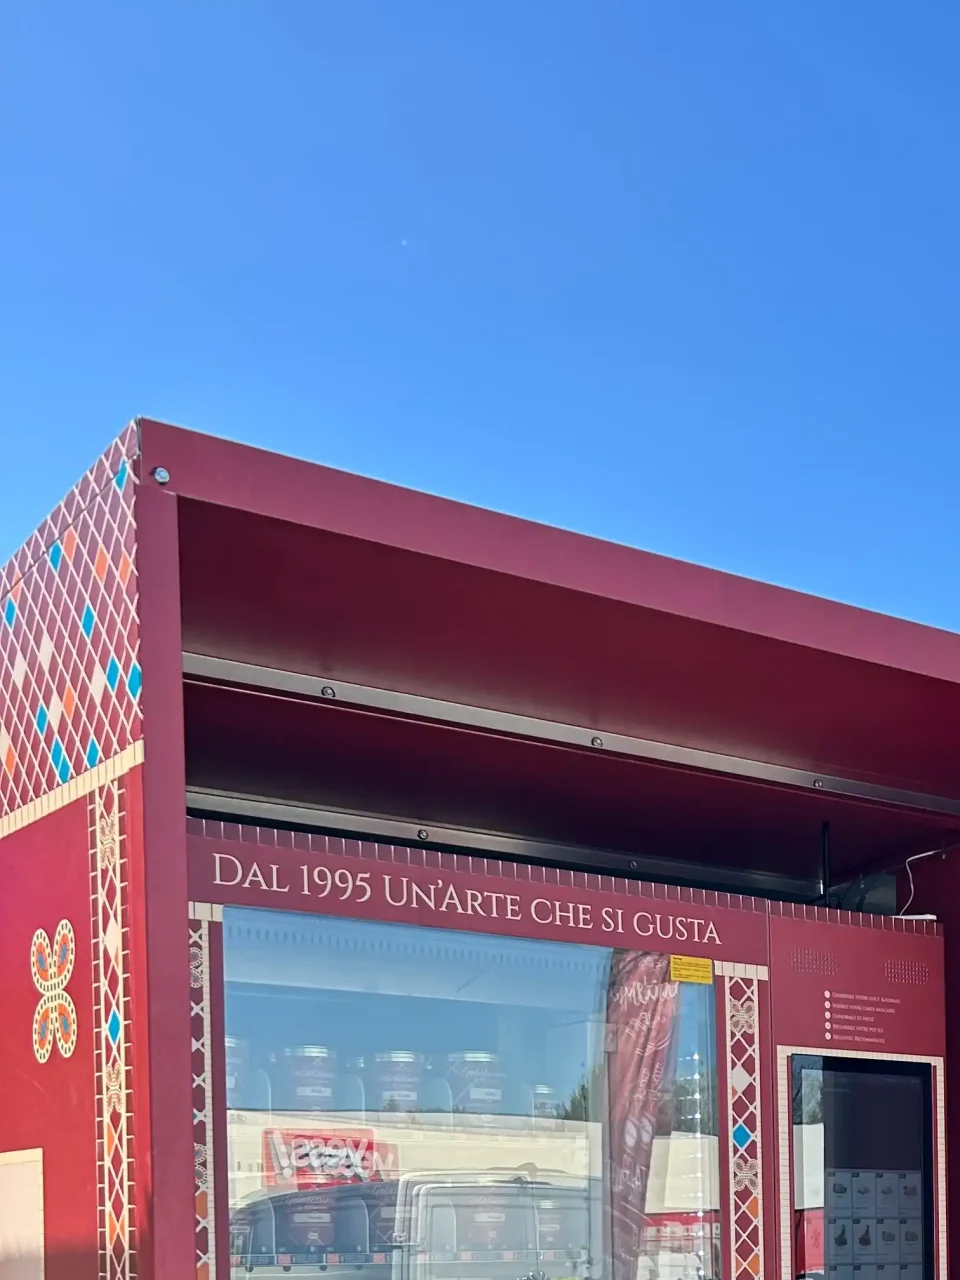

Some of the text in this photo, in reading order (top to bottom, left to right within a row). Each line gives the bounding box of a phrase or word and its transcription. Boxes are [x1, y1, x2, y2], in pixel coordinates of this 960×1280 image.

[300, 864, 372, 904] 1995
[531, 897, 594, 932] CHE
[601, 907, 625, 934] SI
[633, 912, 723, 946] GUSTA
